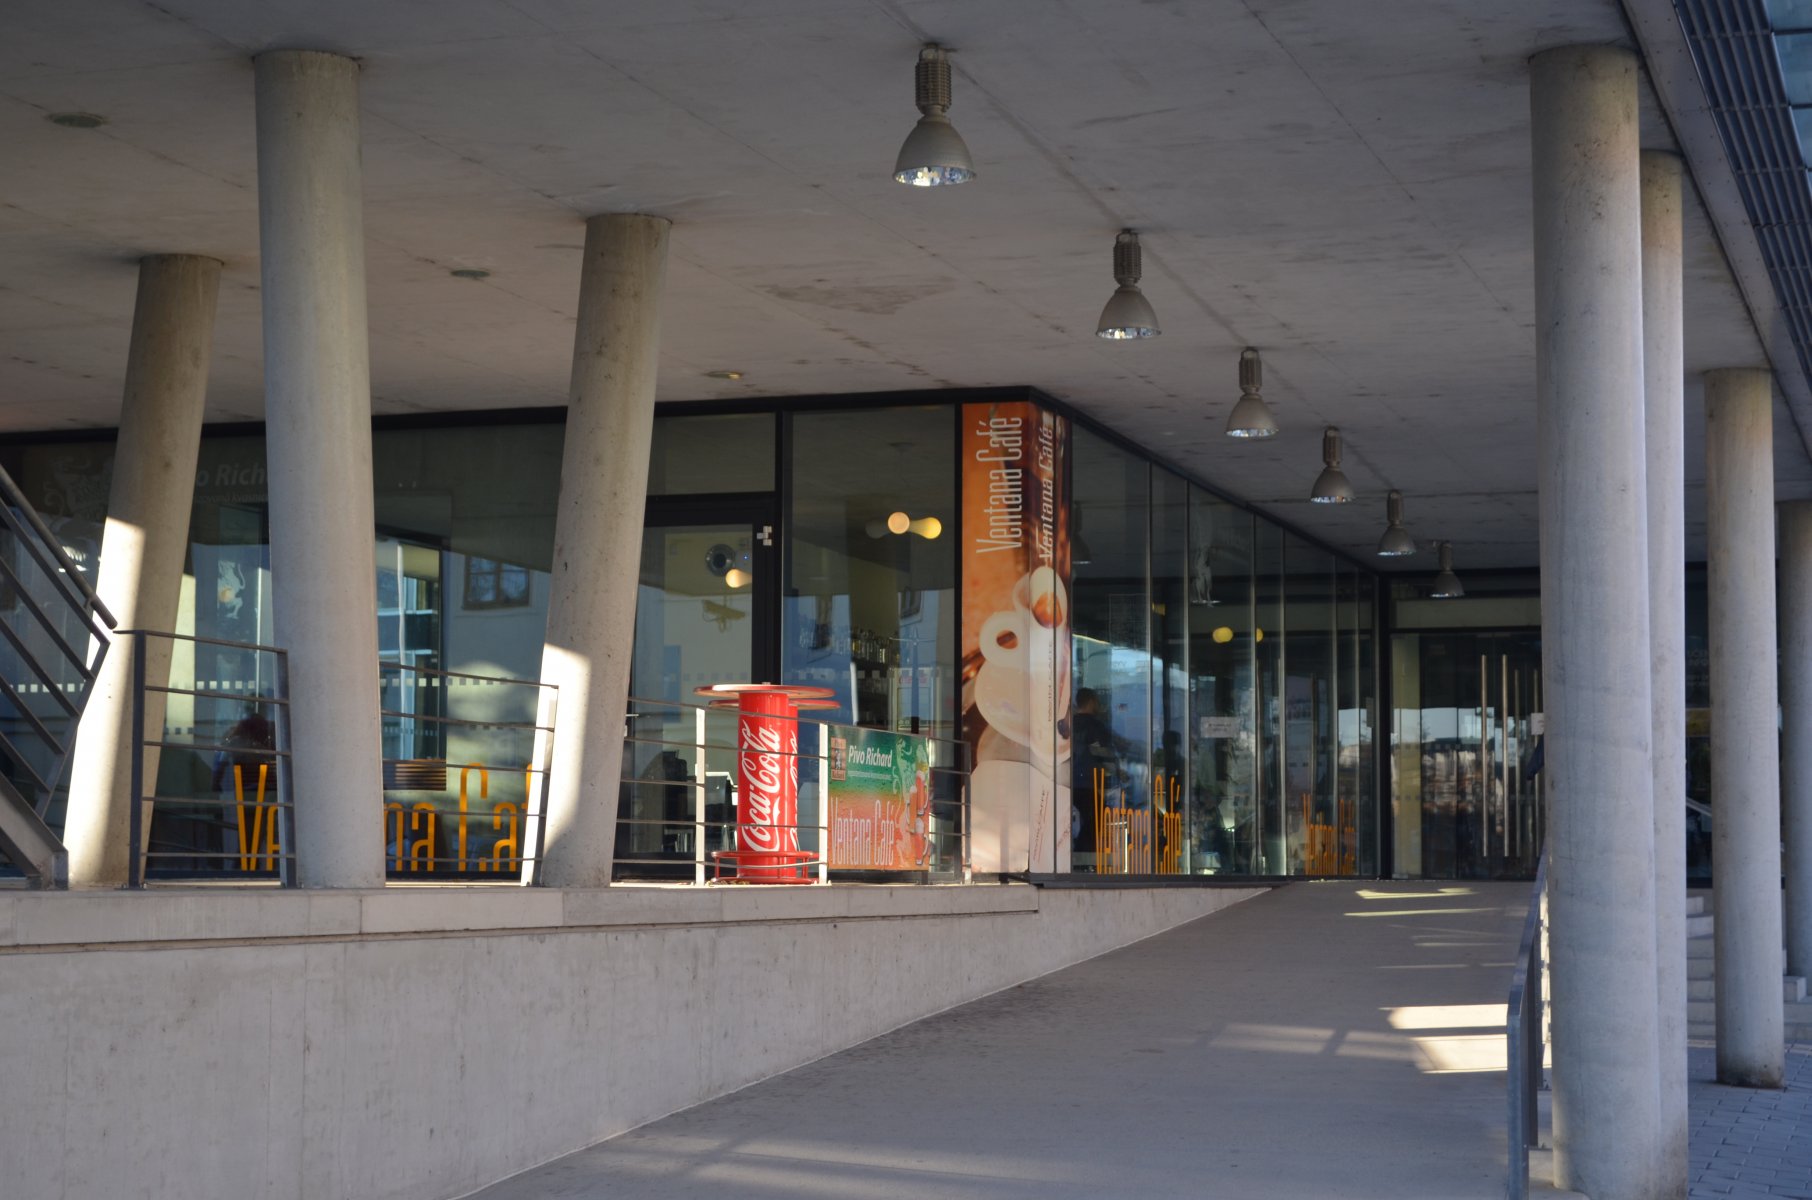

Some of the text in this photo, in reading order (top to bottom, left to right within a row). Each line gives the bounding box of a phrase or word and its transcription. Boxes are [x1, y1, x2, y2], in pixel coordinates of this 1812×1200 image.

[976, 417, 1022, 553] Ventana Café
[1039, 427, 1054, 560] Ventana Café
[742, 720, 780, 851] Coca-Cola
[848, 745, 893, 768] Pivo Richard
[831, 797, 894, 865] Ventana Café
[1094, 768, 1151, 874] Ventana
[1155, 774, 1182, 874] Café
